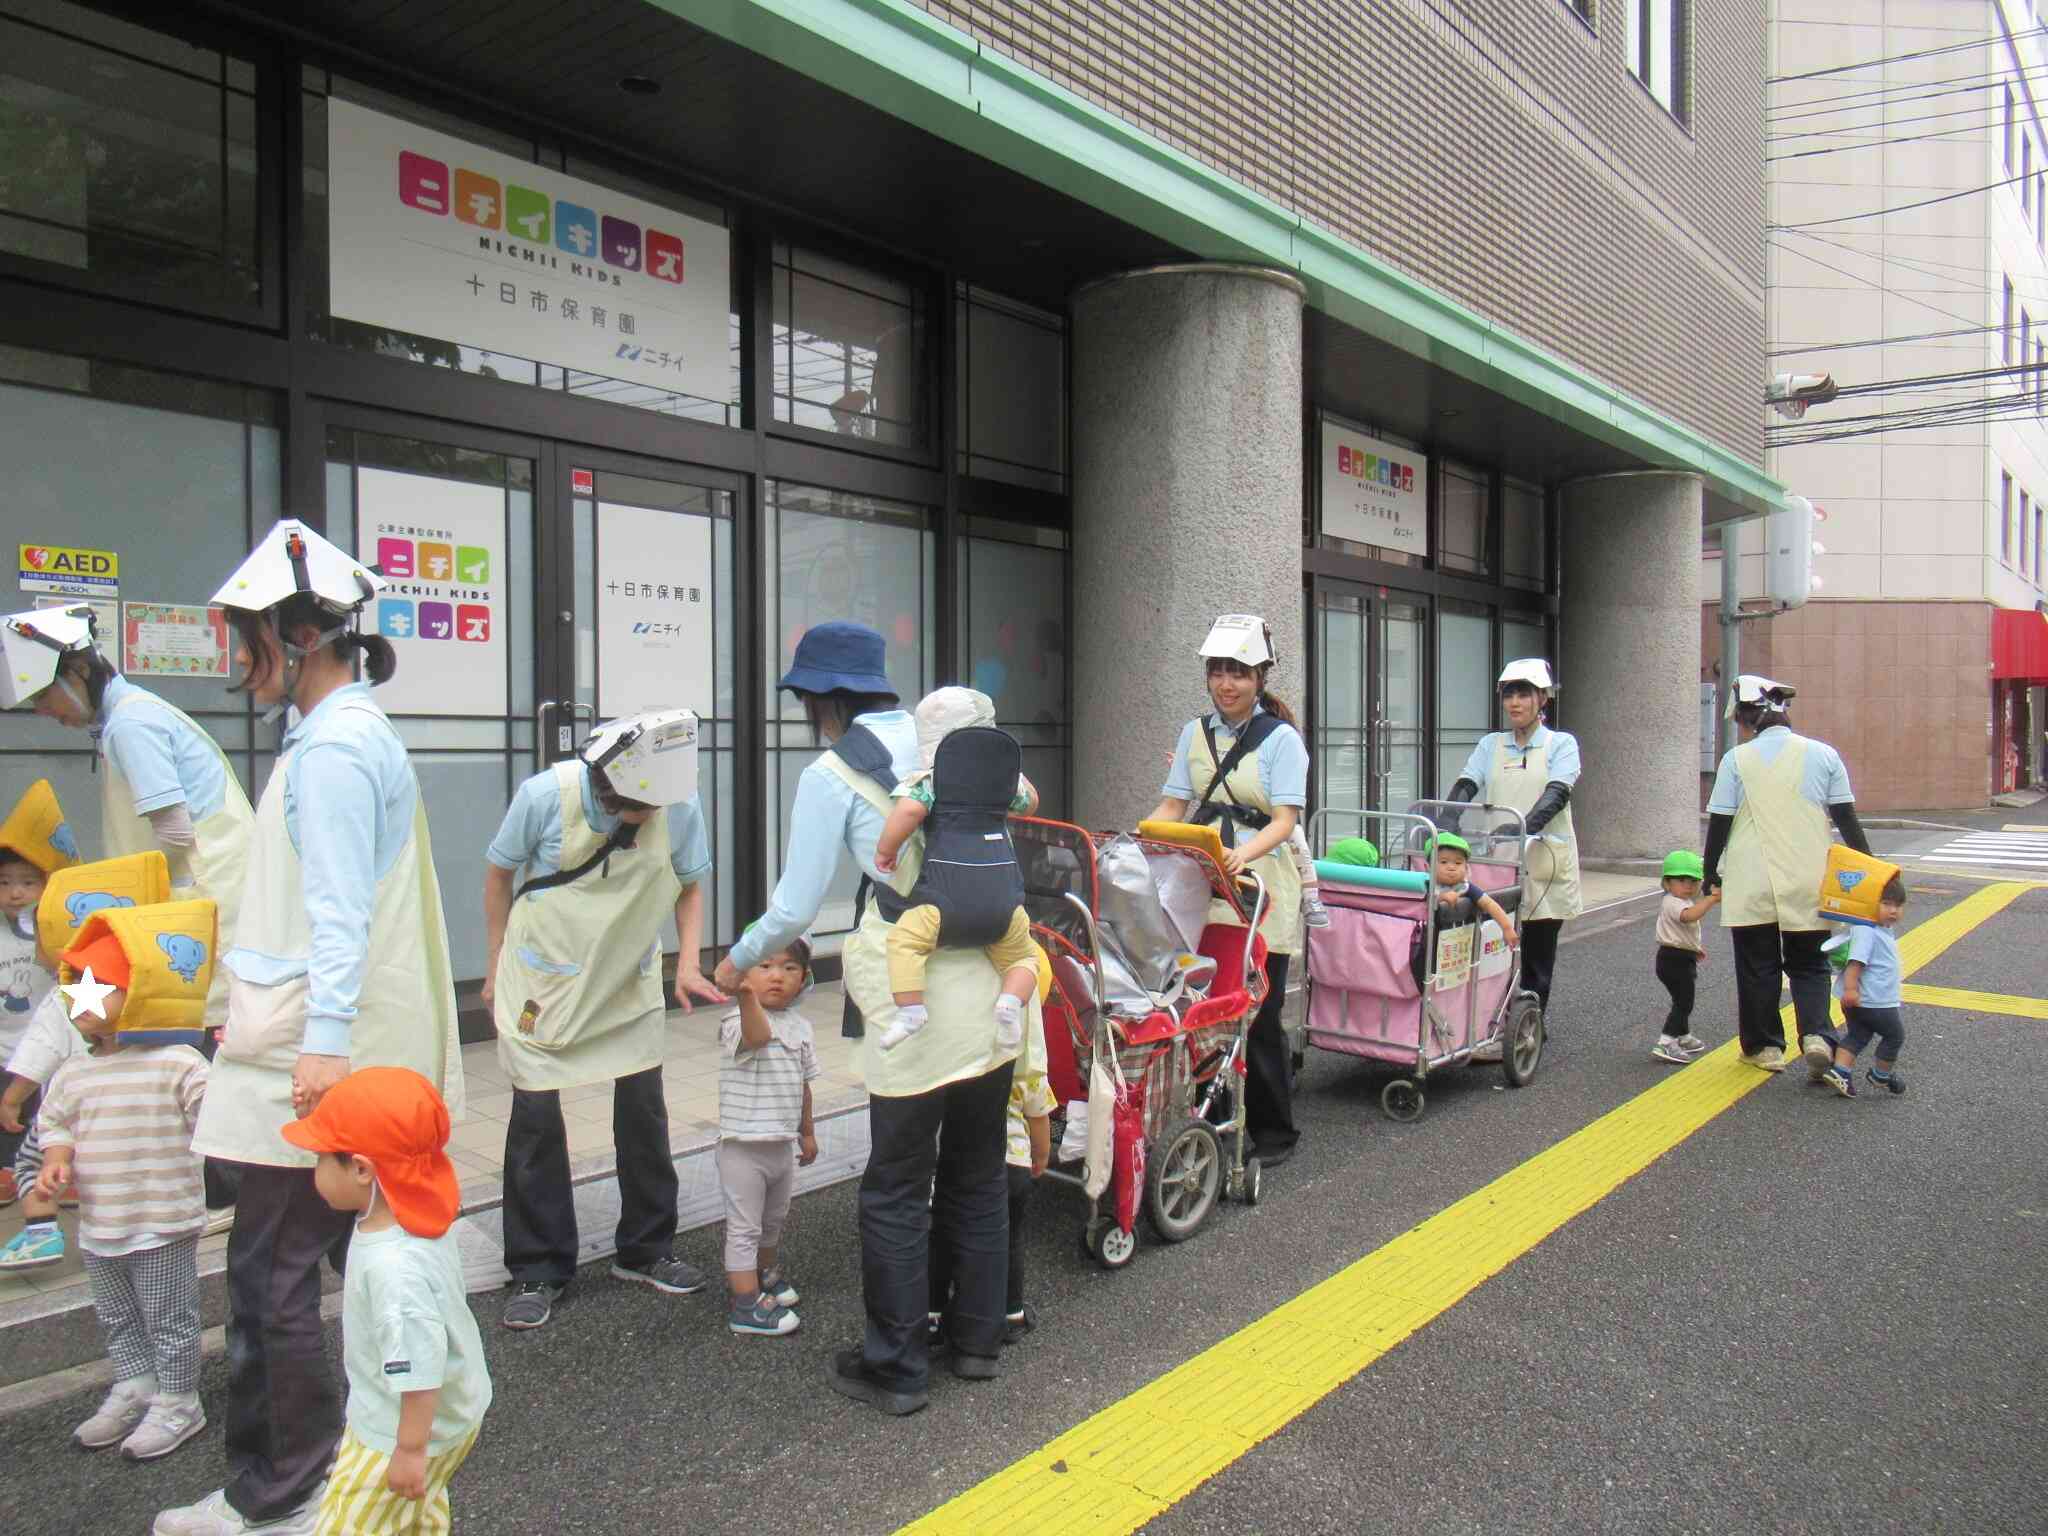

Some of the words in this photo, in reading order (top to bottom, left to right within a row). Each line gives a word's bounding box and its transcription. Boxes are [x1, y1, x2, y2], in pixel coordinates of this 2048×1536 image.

[406, 160, 683, 283] ニチイキッズ
[479, 236, 557, 269] NICHII
[571, 262, 622, 287] KIDS
[465, 272, 636, 335] 十日市保育園
[642, 348, 684, 373] ニチイ
[53, 552, 111, 574] AED
[384, 545, 488, 583] ニチイ
[450, 589, 490, 600] KIDS
[607, 578, 701, 603] 十日市保育園
[383, 606, 488, 640] キッズ
[652, 623, 681, 638] ニチイ
